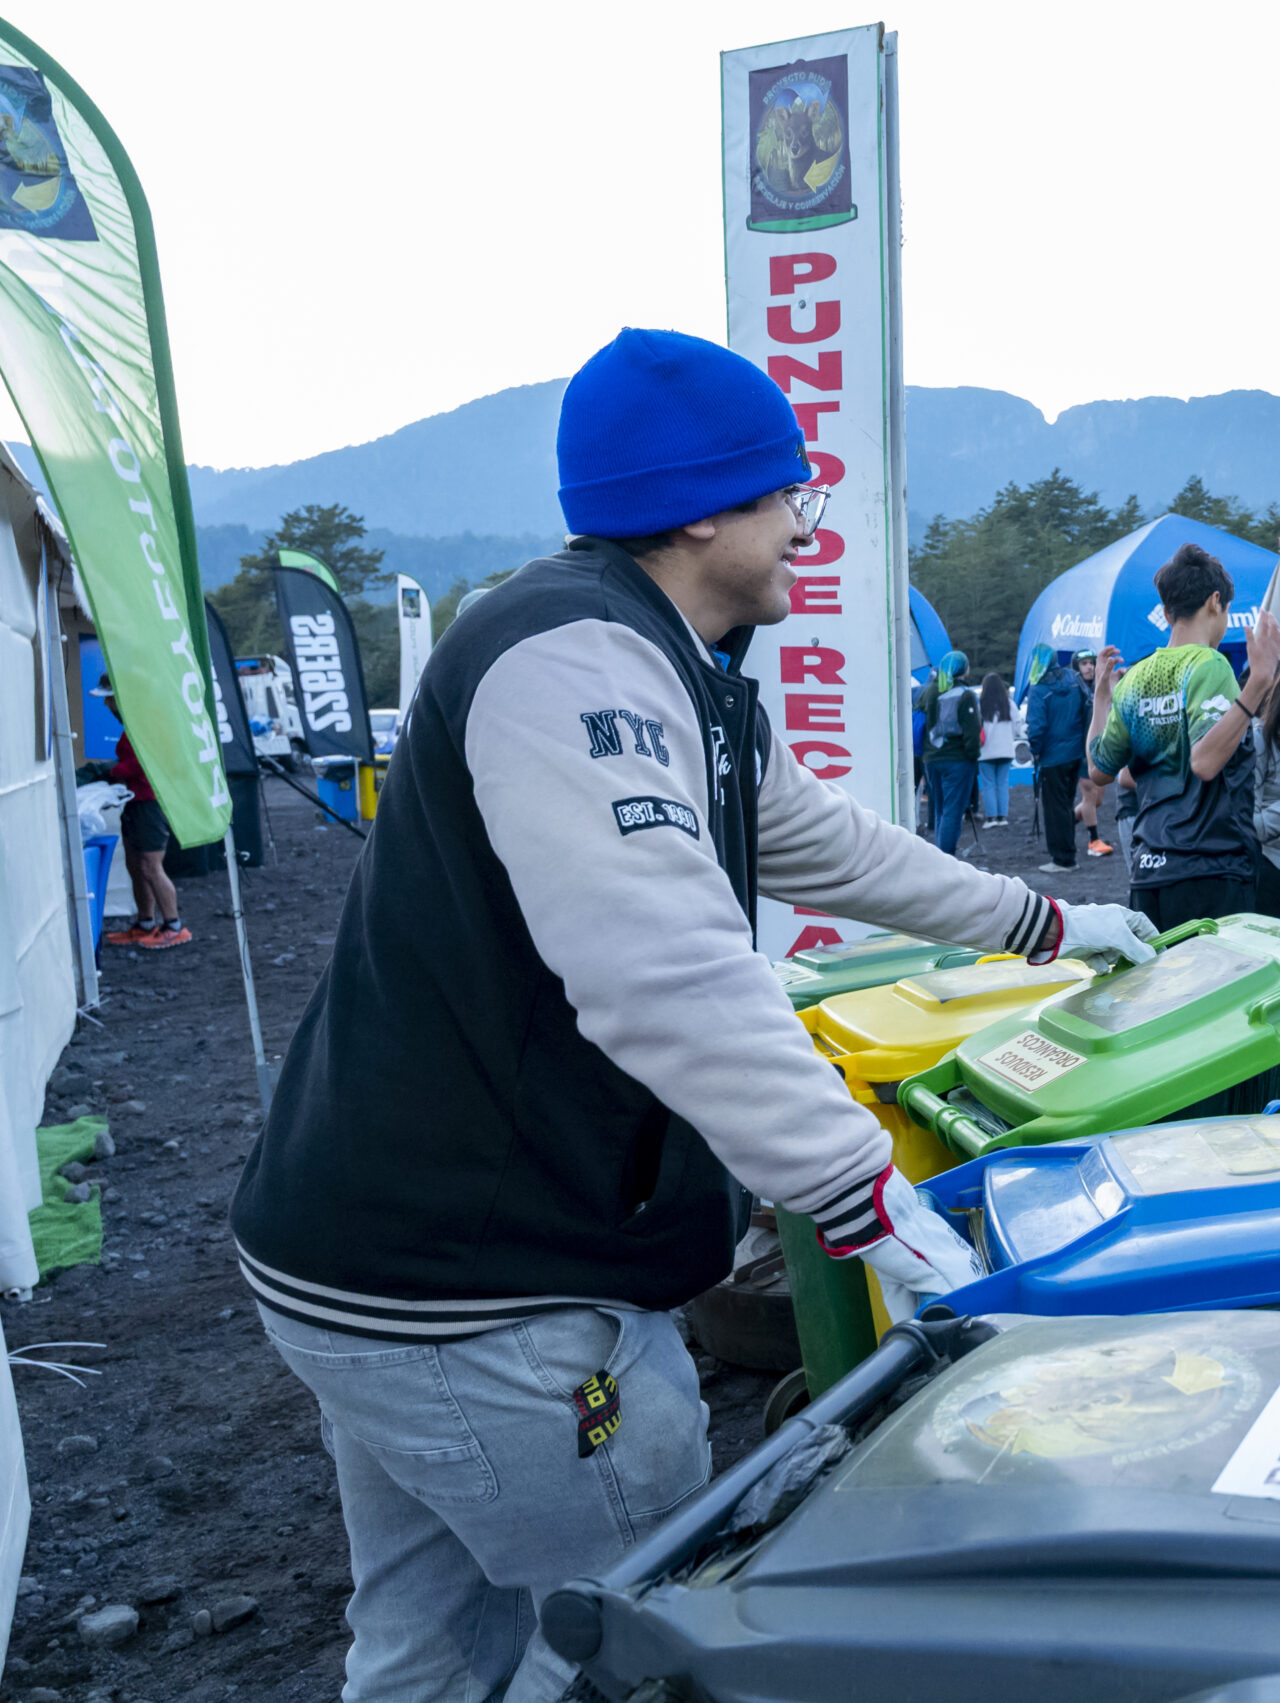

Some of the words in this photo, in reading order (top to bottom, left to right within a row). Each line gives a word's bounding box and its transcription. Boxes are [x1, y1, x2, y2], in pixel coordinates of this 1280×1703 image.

[1061, 613, 1103, 638] Columbia
[580, 710, 669, 767] NYC
[617, 802, 664, 827] EST.
[995, 1051, 1048, 1081] RESIDUOS
